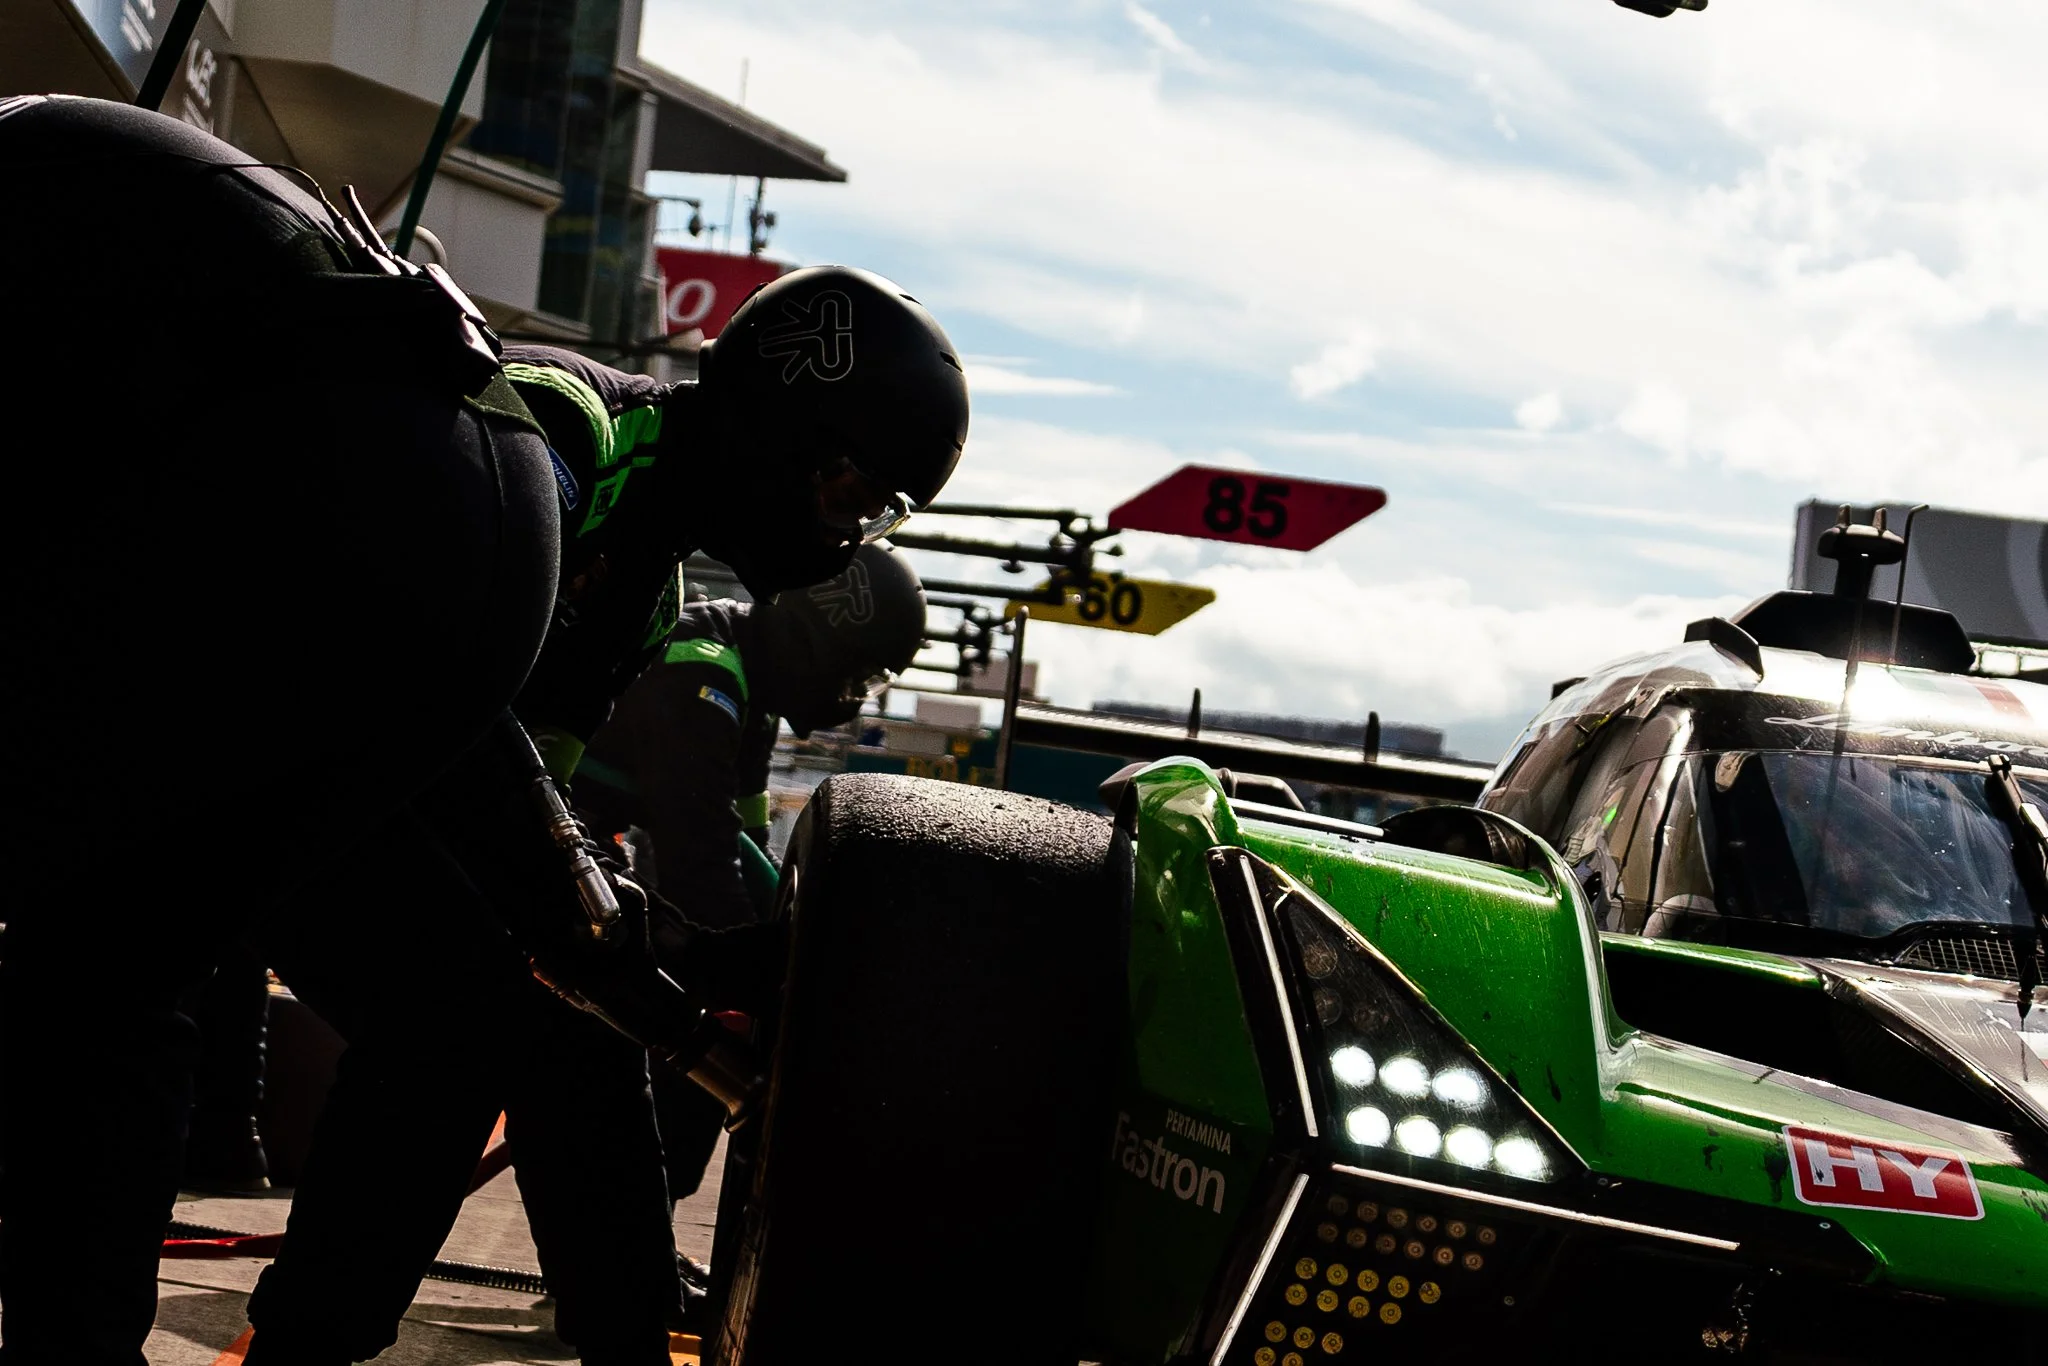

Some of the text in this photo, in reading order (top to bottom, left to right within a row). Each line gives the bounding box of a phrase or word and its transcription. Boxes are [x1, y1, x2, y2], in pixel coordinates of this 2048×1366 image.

[1203, 477, 1289, 537] 85
[1079, 579, 1142, 625] 60
[1165, 1107, 1231, 1156] PERTAMINA
[1111, 1109, 1226, 1215] Fastron
[1804, 1137, 1952, 1200] HY
